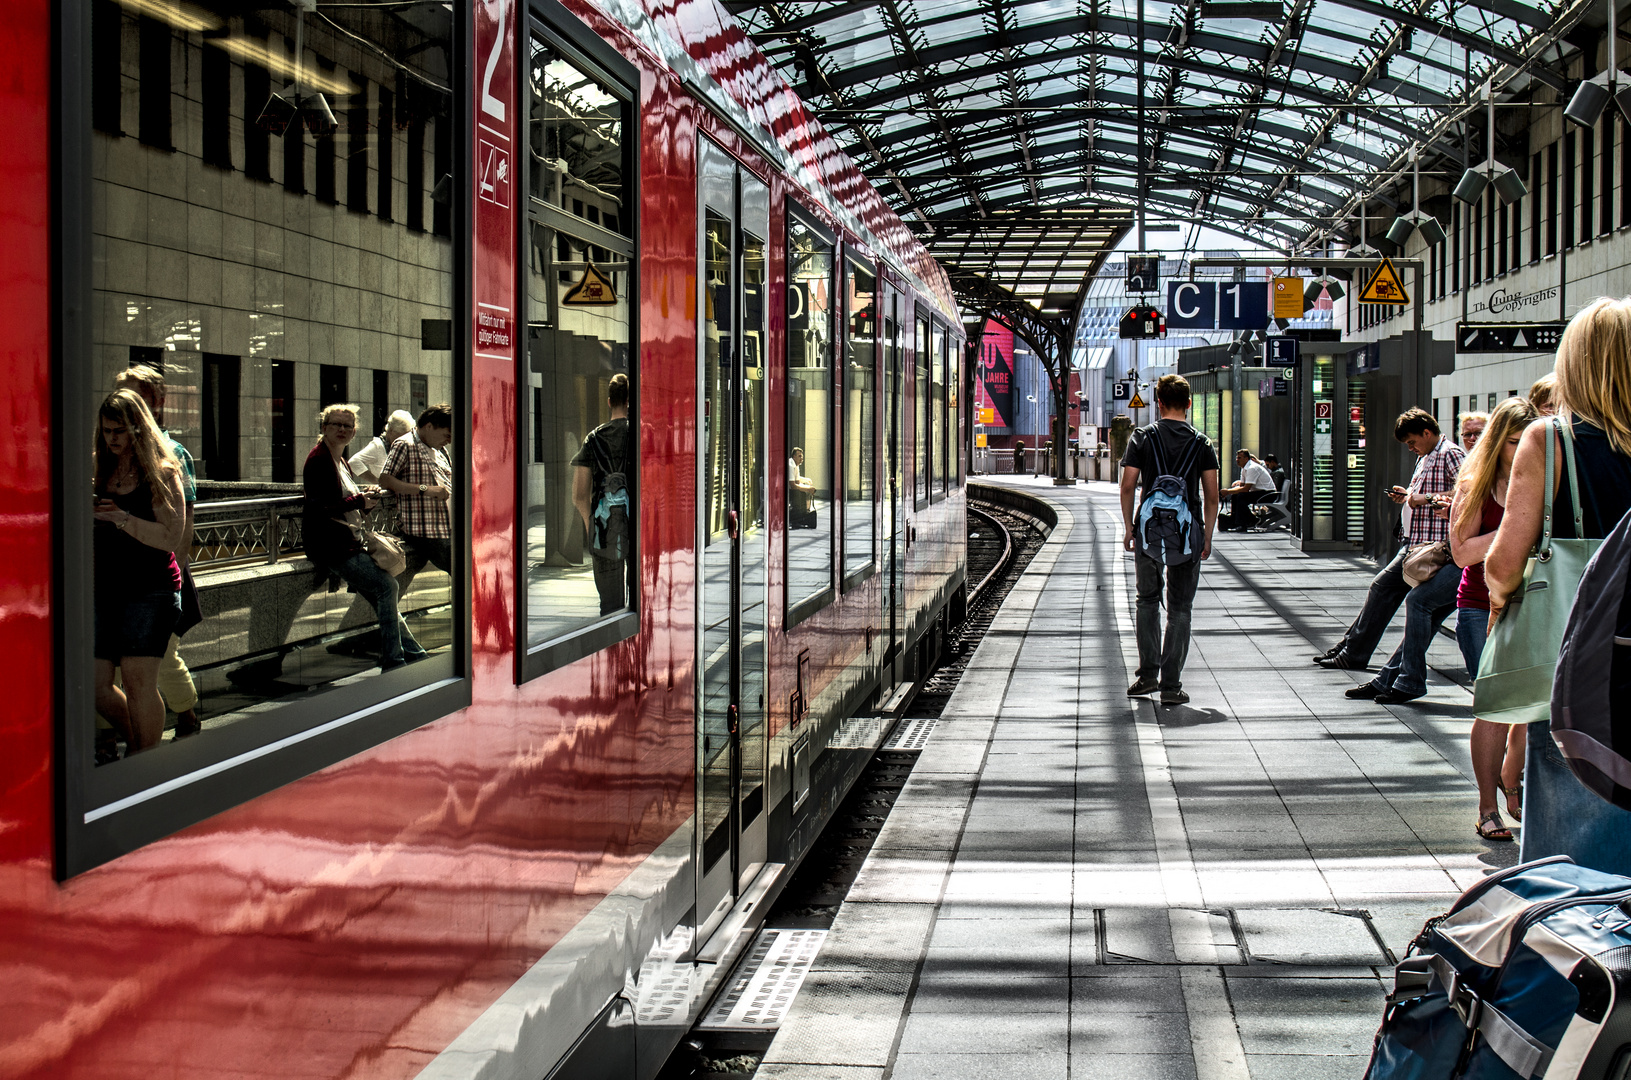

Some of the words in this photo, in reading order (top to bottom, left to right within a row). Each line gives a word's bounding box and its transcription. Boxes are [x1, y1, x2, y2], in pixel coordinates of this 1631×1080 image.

[1174, 283, 1200, 318] C
[1226, 284, 1240, 318] 1
[985, 372, 1009, 384] JAHRE
[1115, 384, 1124, 397] B
